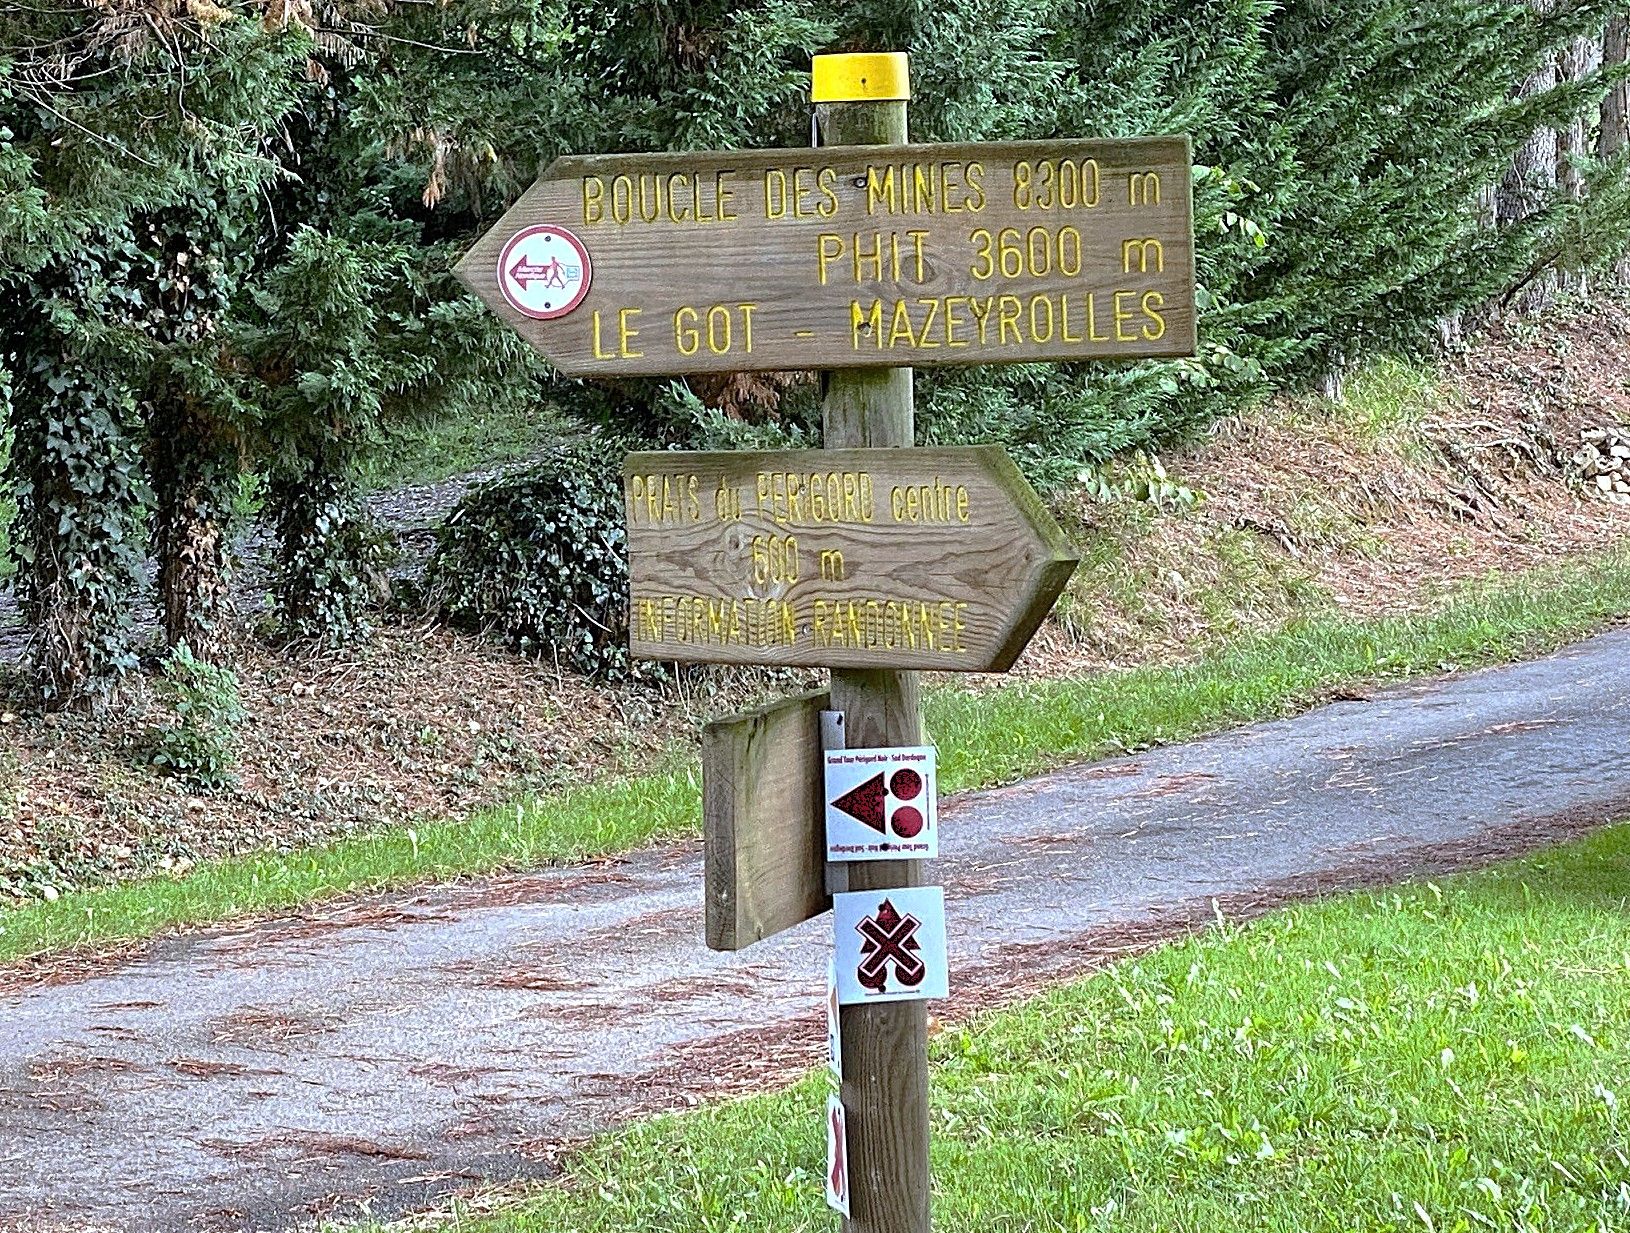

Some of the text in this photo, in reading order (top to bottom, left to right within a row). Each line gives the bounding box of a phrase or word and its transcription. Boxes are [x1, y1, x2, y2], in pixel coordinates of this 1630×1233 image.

[583, 158, 1161, 226] BOUCLE DES MINES 8300 m
[817, 225, 1164, 286] PHIT 3600 m
[592, 307, 645, 360] LE
[674, 303, 757, 356] GOT
[850, 290, 1166, 350] MAZEYROLLES
[631, 471, 970, 524] PRATS du PERIGORD centre
[752, 534, 845, 585] 600 m
[637, 596, 968, 652] INFORMATION RANDONNEE
